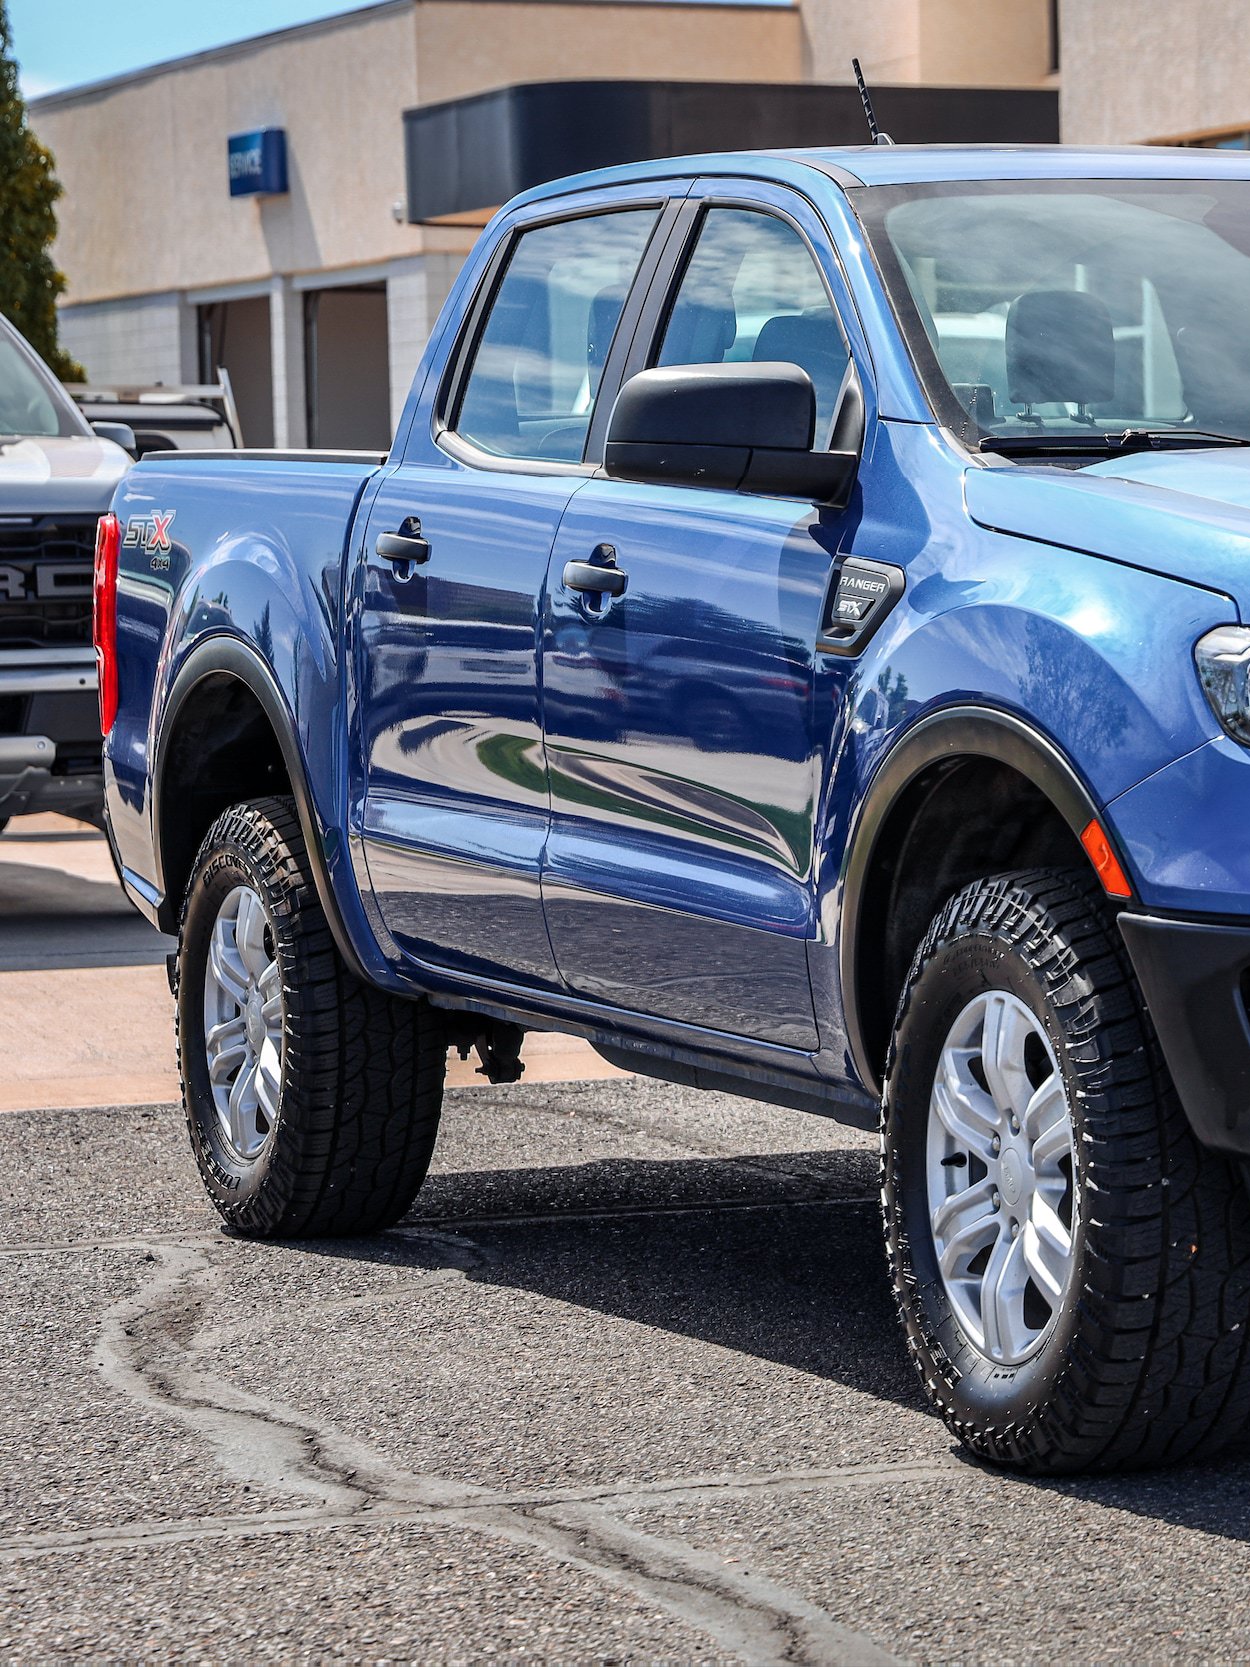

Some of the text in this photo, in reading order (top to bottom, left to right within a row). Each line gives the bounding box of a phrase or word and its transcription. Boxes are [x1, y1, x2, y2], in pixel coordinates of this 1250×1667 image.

[122, 509, 176, 555] STX
[839, 576, 886, 594] RANGER
[836, 600, 863, 617] STX
